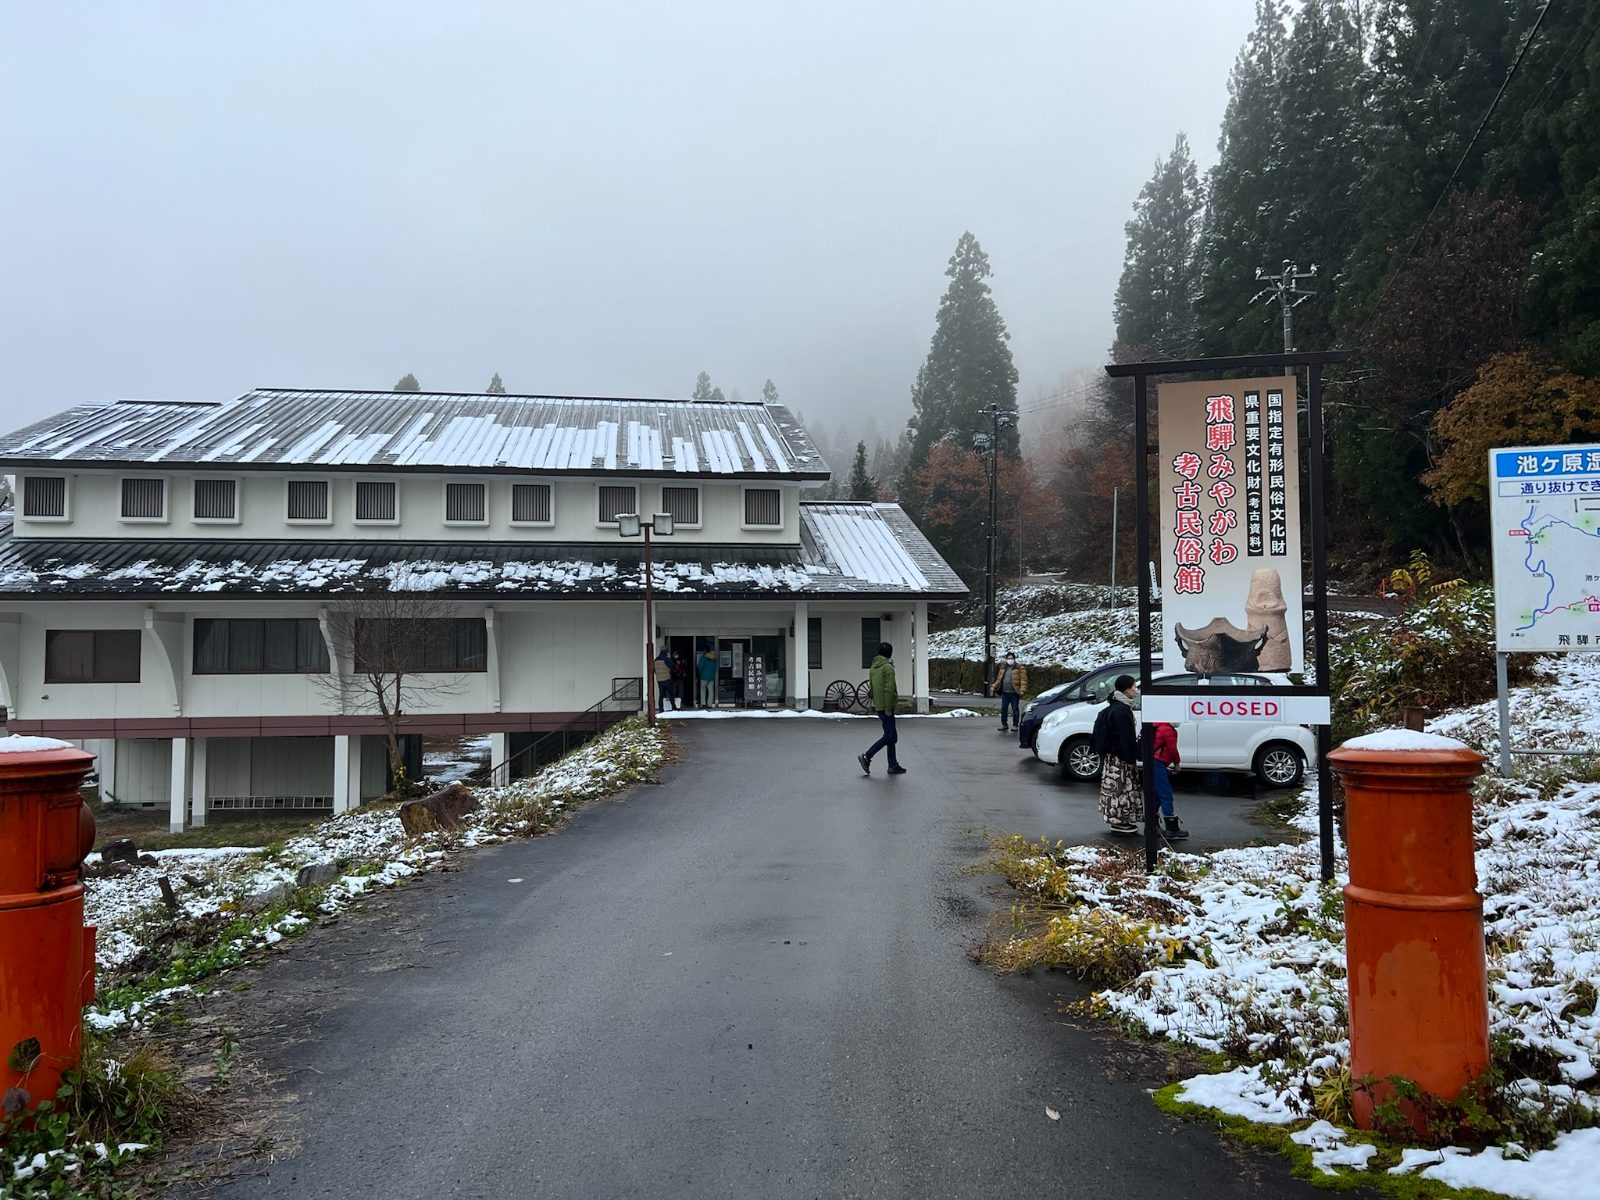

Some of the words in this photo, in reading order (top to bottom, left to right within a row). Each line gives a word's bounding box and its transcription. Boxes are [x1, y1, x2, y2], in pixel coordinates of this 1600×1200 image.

[1173, 453, 1205, 594] 考古民俗館
[1268, 393, 1286, 554] 国指定有形民俗文化財
[1191, 701, 1279, 716] CLOSED
